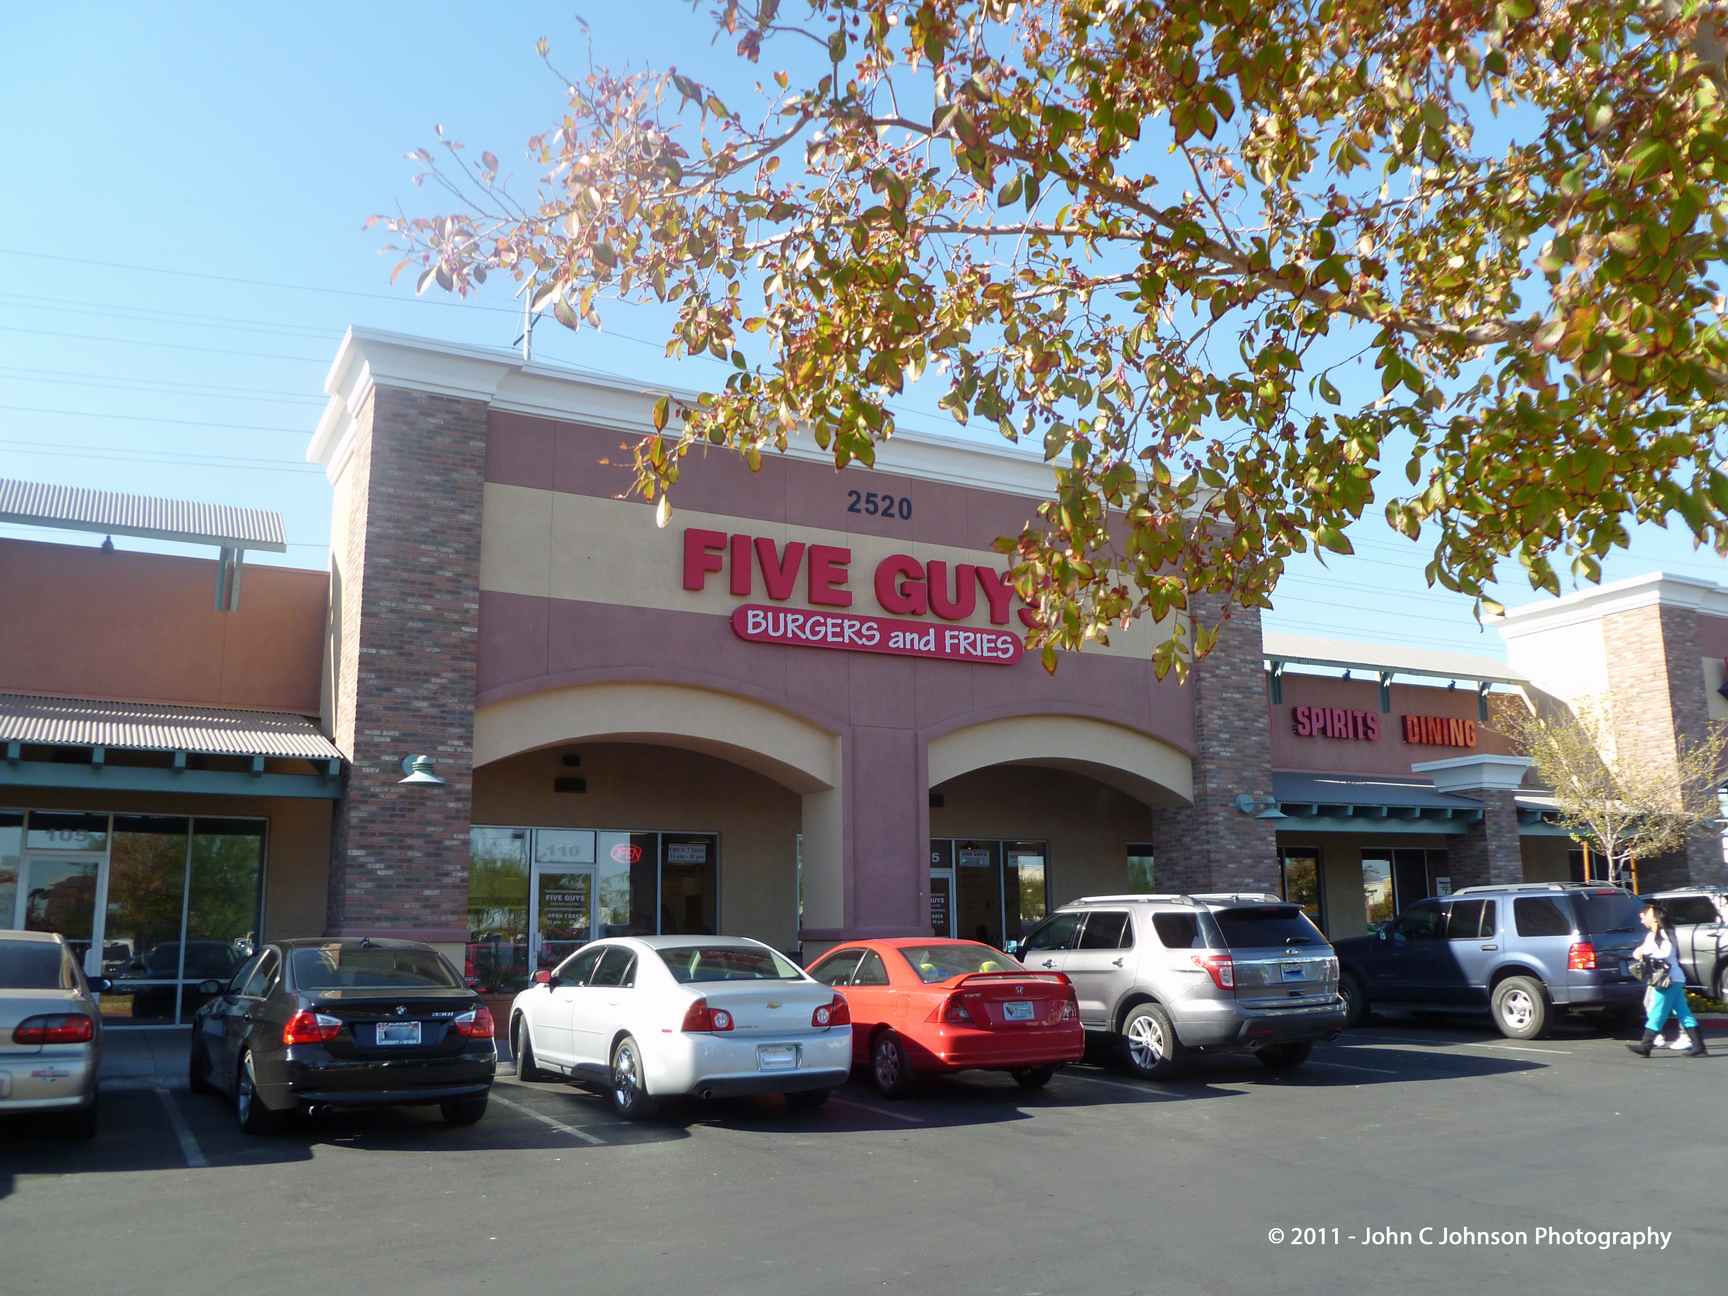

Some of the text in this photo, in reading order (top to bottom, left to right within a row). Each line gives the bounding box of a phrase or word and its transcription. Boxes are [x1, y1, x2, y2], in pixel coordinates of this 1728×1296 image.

[847, 489, 912, 520] 2520
[683, 527, 852, 607] FIVE
[746, 609, 1014, 659] BURGERS and FRIES
[1292, 705, 1380, 741] SPIRITS
[1401, 714, 1478, 748] DINING
[45, 828, 89, 842] 105
[546, 844, 581, 857] 110
[610, 846, 643, 860] OPEN
